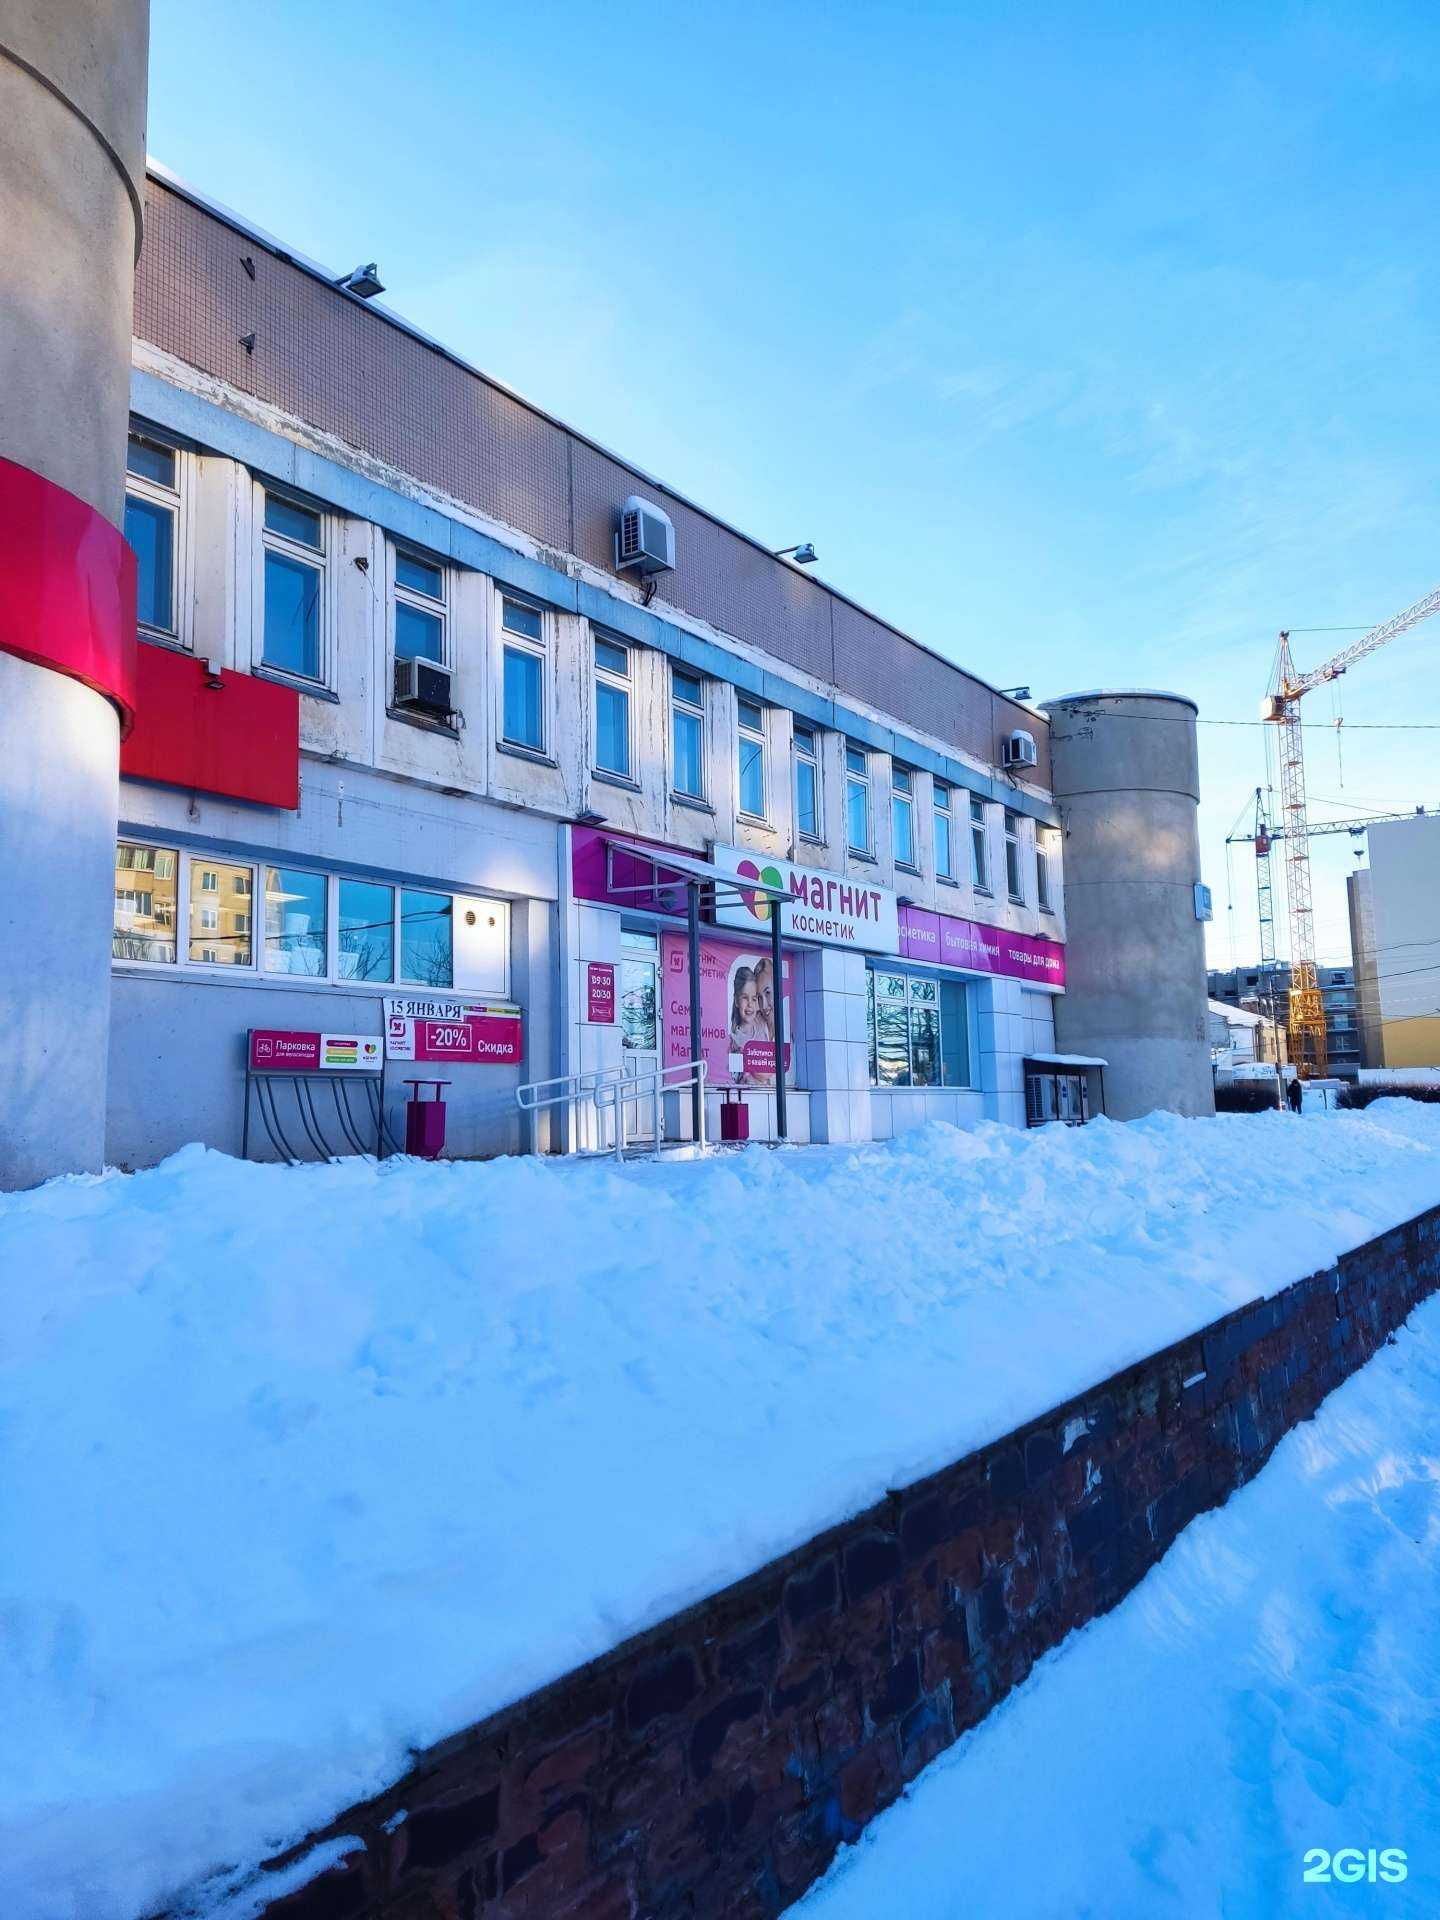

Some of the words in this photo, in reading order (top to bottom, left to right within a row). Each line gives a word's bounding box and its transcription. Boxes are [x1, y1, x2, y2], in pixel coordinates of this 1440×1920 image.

[791, 913, 855, 940] косметик
[896, 925, 937, 944] осметика
[945, 931, 978, 951] бытовая
[979, 941, 1000, 957] химия
[1008, 949, 1032, 964] товары
[1032, 954, 1045, 968] для
[1045, 957, 1060, 970] дома
[391, 1000, 404, 1014] 15
[406, 1001, 462, 1019] ЯНВАРЯ
[430, 1028, 467, 1047] -20%
[671, 1025, 726, 1040] магинов
[275, 1040, 316, 1054] Парковка
[477, 1040, 514, 1055] Скидка
